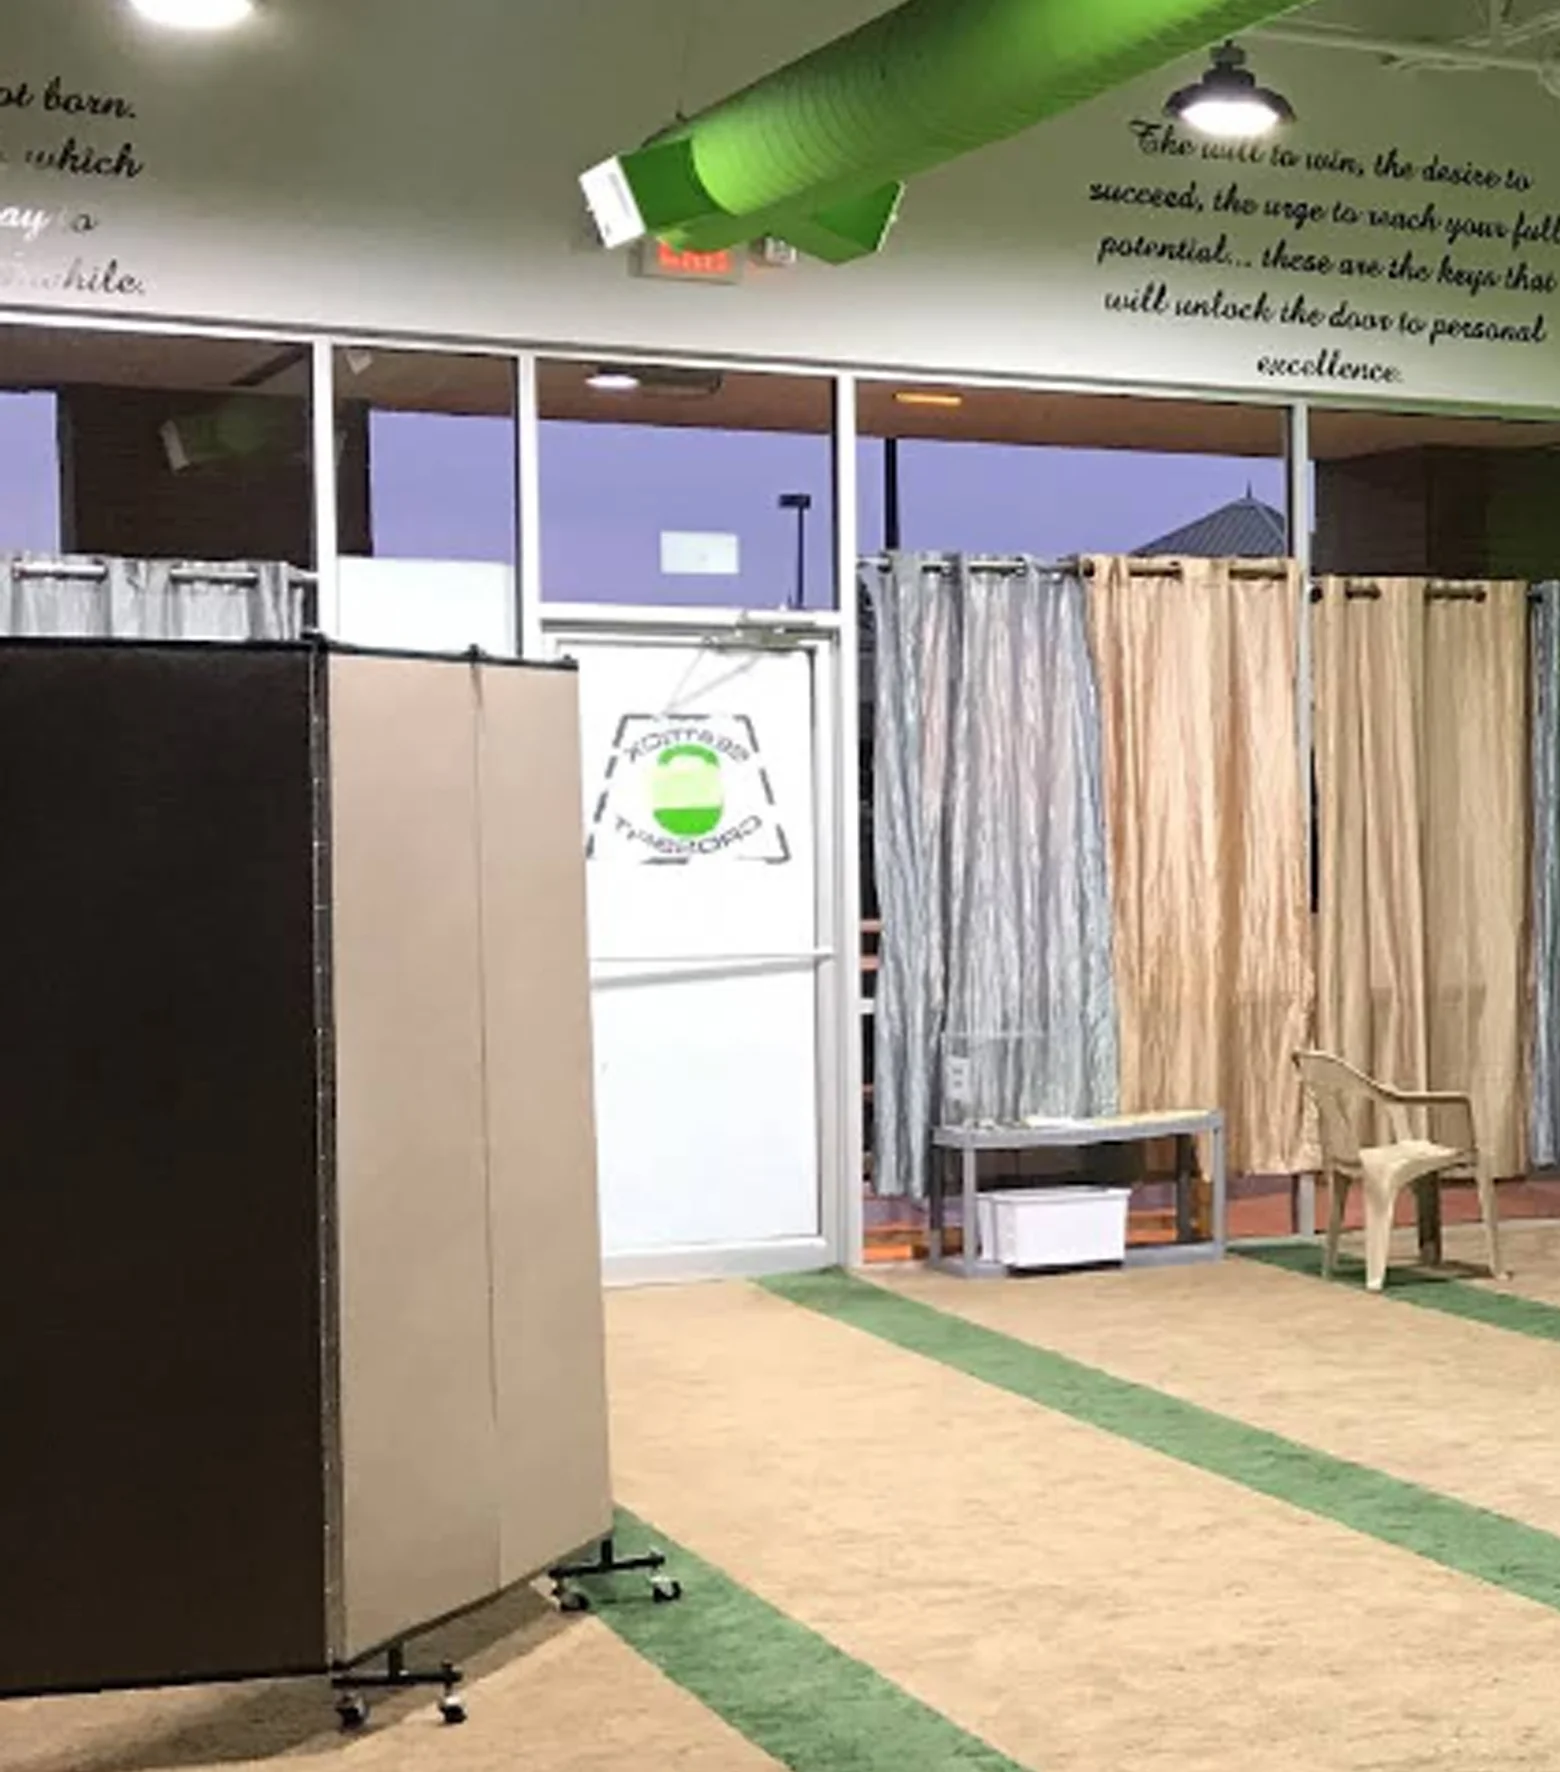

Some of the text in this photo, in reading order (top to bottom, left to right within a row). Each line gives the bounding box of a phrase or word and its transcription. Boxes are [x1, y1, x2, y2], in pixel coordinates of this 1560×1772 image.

[43, 75, 137, 120] born.
[24, 136, 145, 179] which
[1128, 118, 1197, 156] The
[1269, 144, 1300, 168] to
[1305, 148, 1365, 177] win,
[1373, 147, 1415, 181] the
[1421, 153, 1501, 188] desire
[1503, 168, 1535, 192] to
[1088, 179, 1204, 214] succeed,
[1211, 181, 1259, 216] the
[1263, 198, 1328, 230] urge
[1331, 201, 1362, 223] to
[1368, 201, 1442, 232] reach
[1444, 216, 1508, 245] your
[1097, 232, 1559, 297] potential... these are the keys that
[1103, 282, 1548, 346] will unlock the door to personal
[1256, 347, 1404, 383] excellence.
